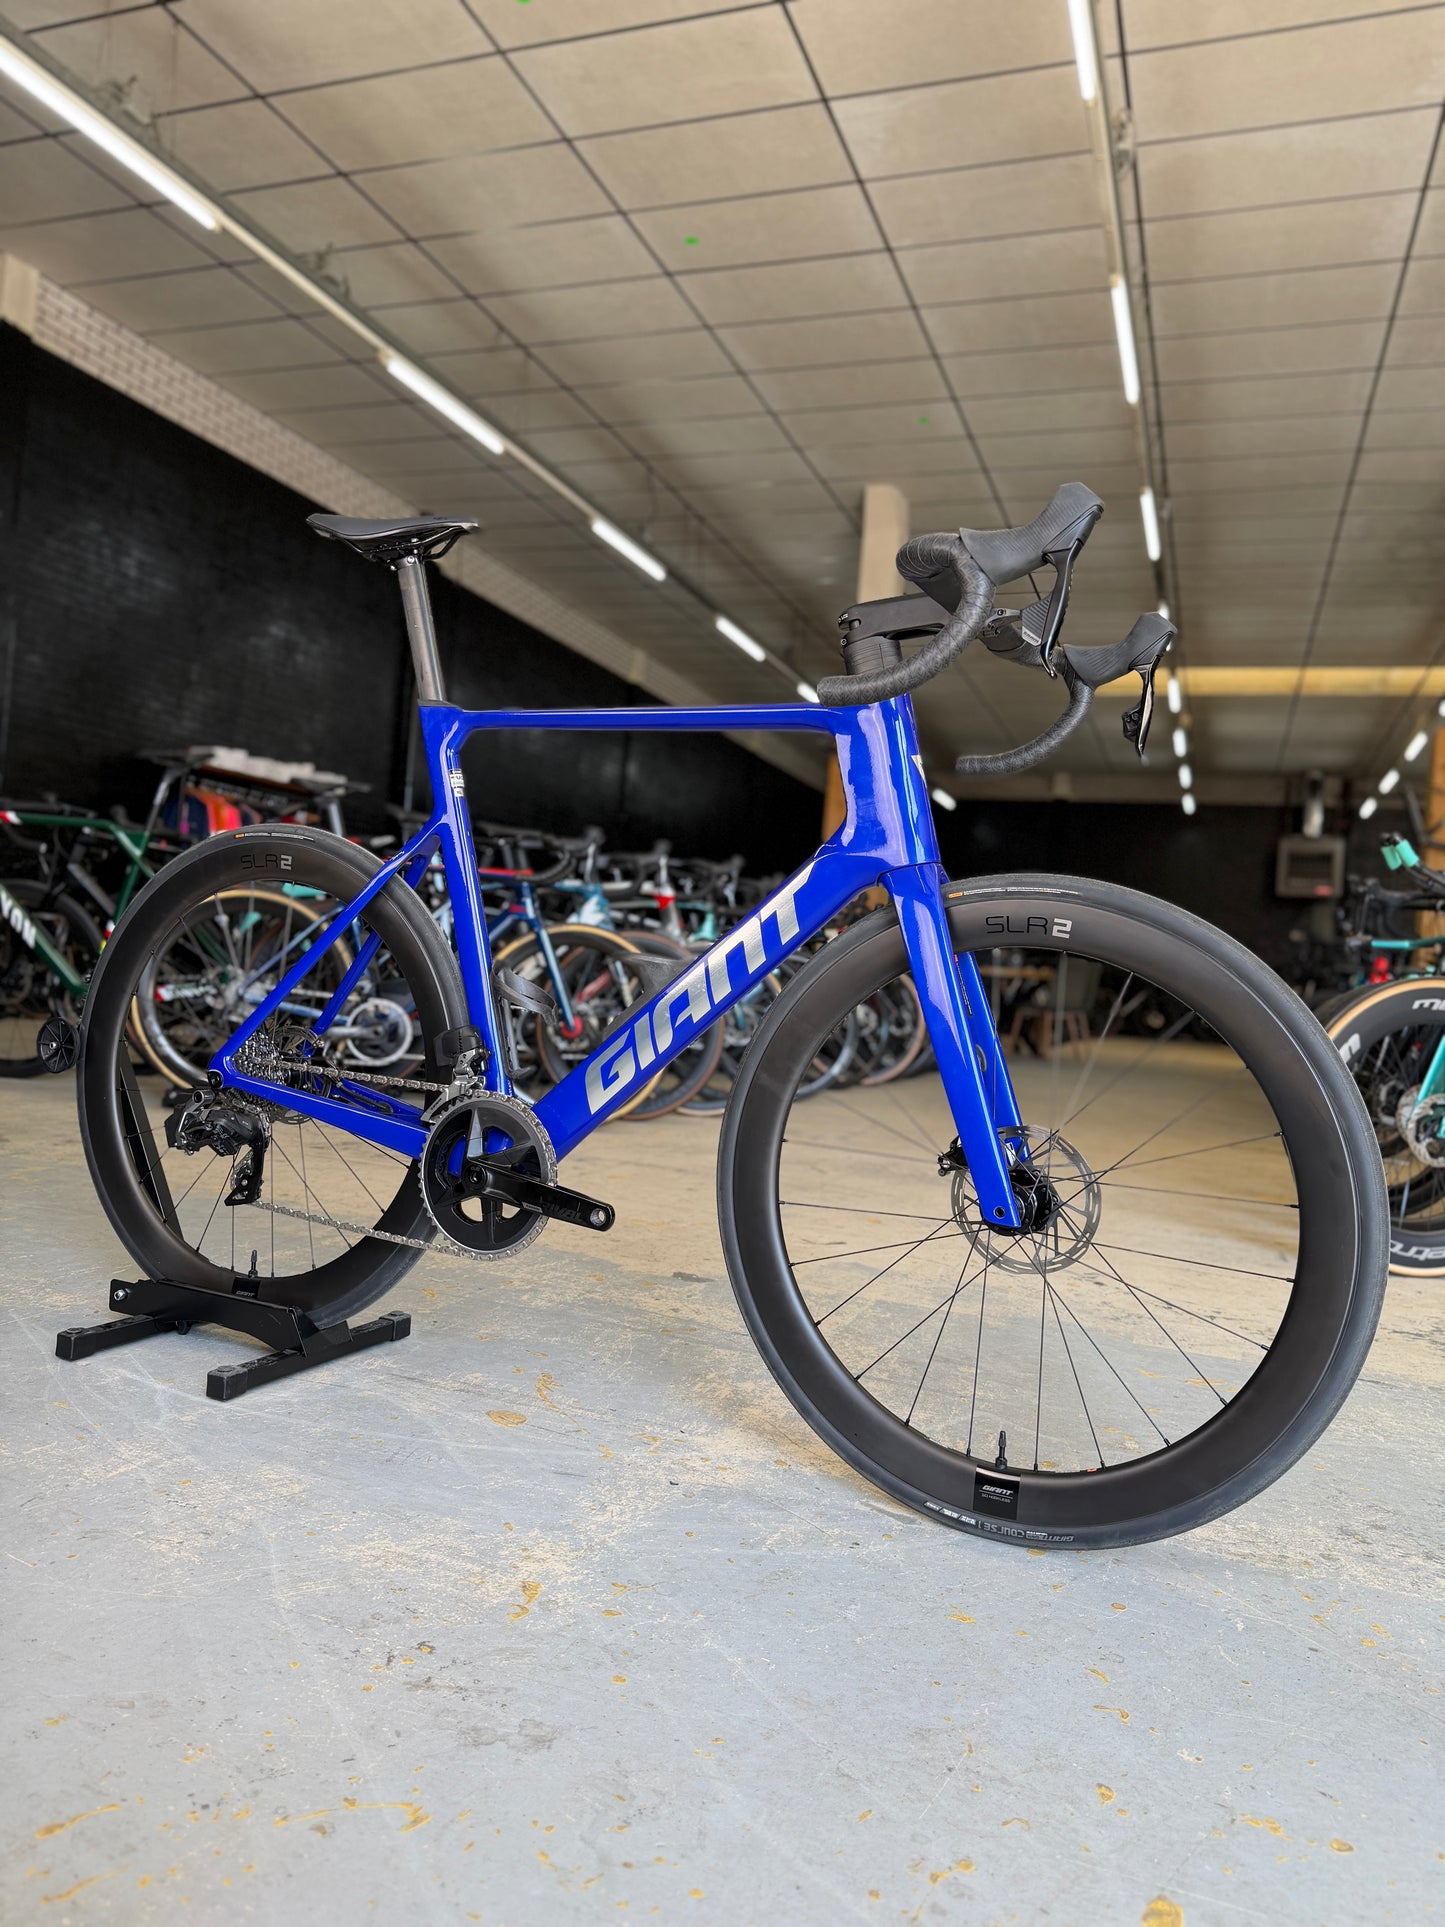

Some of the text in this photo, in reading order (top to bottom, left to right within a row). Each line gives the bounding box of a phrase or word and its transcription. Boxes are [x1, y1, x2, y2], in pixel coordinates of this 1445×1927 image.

[585, 860, 816, 1115] GIANT
[982, 1484, 1013, 1496] GIANT
[983, 1522, 1025, 1538] COURSE
